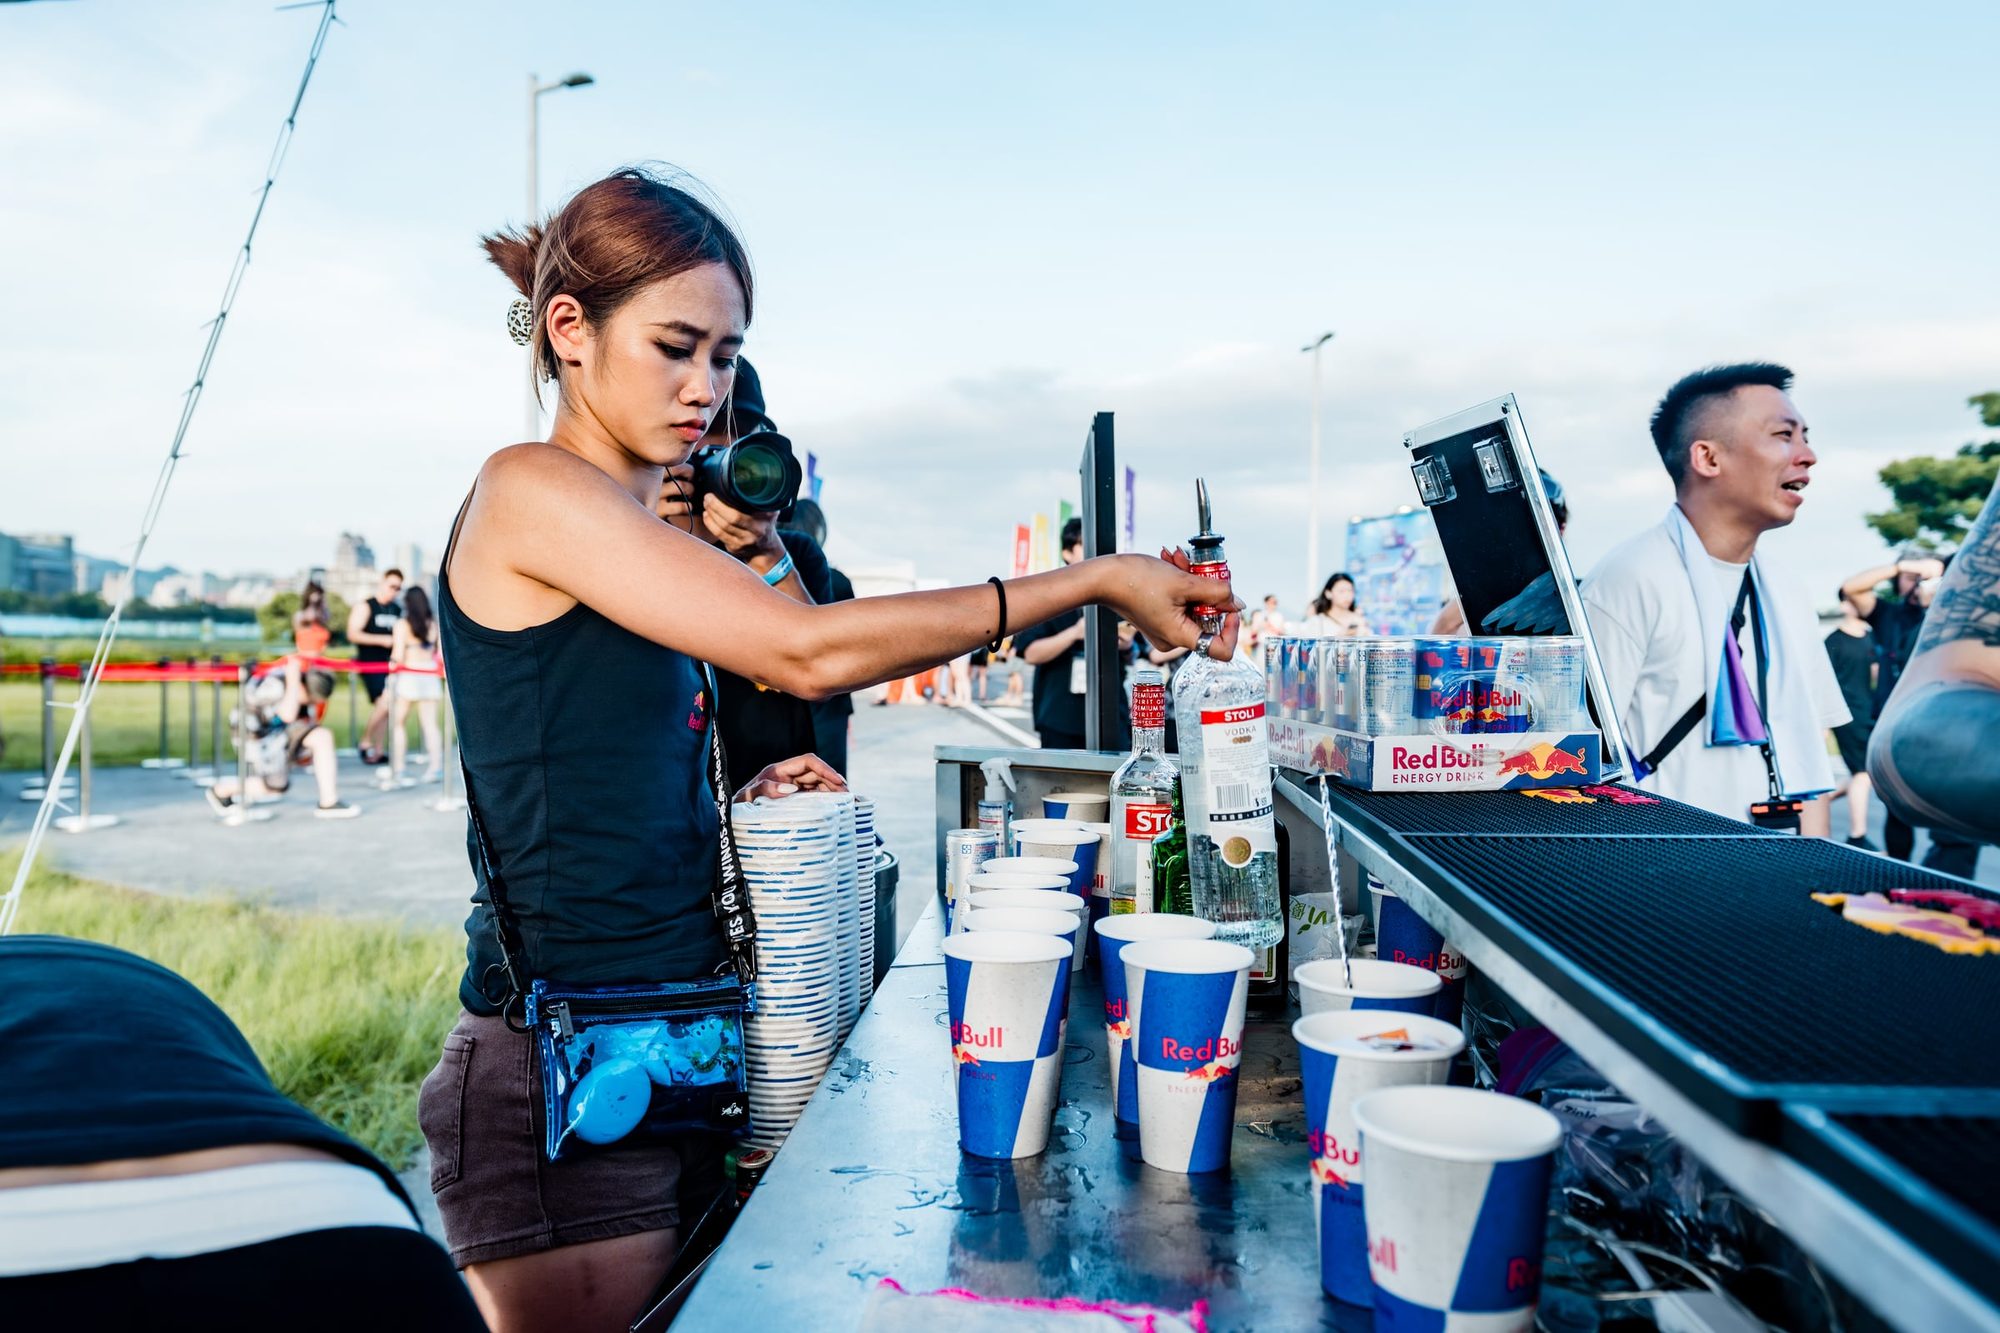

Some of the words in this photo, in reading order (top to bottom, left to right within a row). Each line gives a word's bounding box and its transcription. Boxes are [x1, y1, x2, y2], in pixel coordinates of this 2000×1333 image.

[1490, 689, 1521, 707] Bull
[1223, 708, 1255, 721] STOLI
[1224, 725, 1257, 737] VODKA
[1392, 745, 1437, 770] Red
[1441, 743, 1484, 768] Bull
[1392, 771, 1442, 784] ENERGY
[1446, 770, 1484, 782] DRINK
[719, 826, 737, 884] WINGS
[721, 884, 740, 914] YOU
[1104, 998, 1122, 1018] ed
[961, 1024, 1002, 1048] Bull
[1161, 1036, 1213, 1061] Red
[1323, 1133, 1361, 1167] Bu
